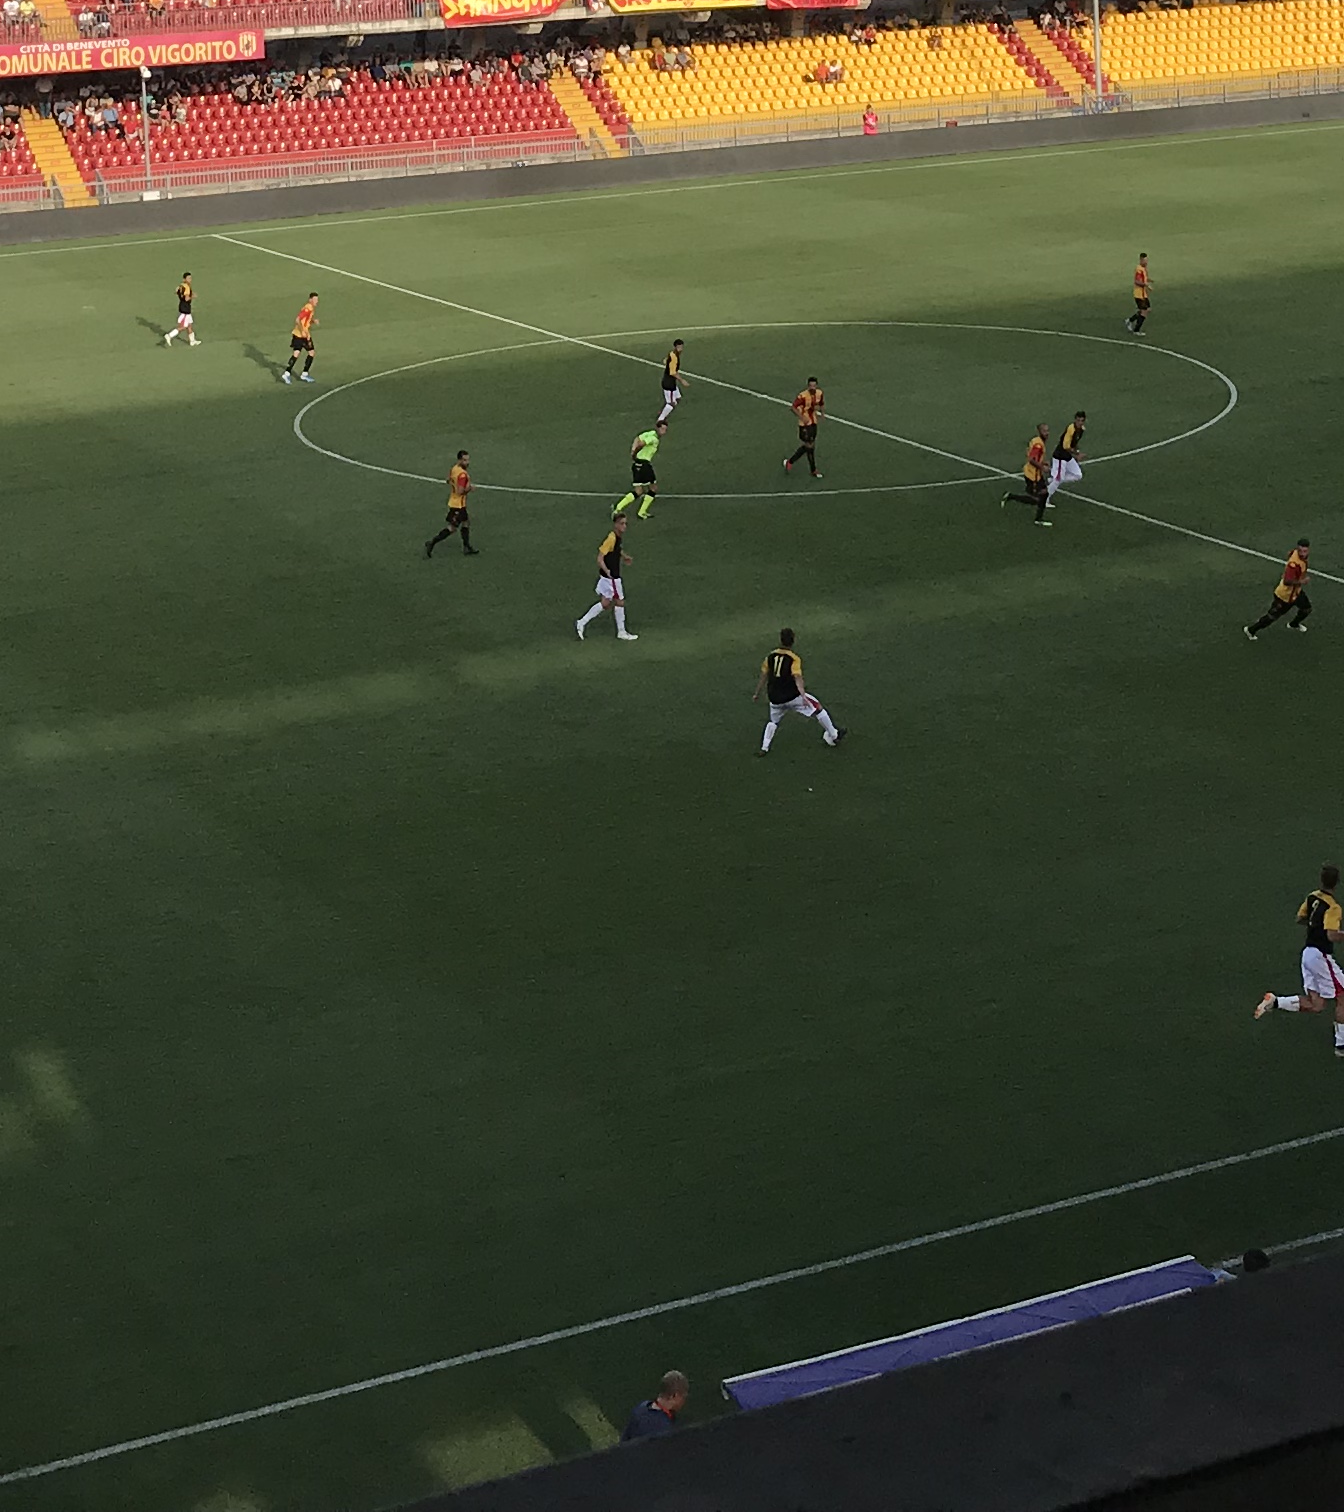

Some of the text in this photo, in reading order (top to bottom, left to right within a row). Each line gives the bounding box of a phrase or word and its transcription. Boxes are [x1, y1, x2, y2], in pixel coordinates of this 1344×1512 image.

[20, 43, 50, 53] CITTÀ
[66, 39, 130, 50] BENEVENTO
[100, 46, 145, 68] CIRO
[147, 40, 236, 64] VIGORITO
[774, 655, 784, 677] 11
